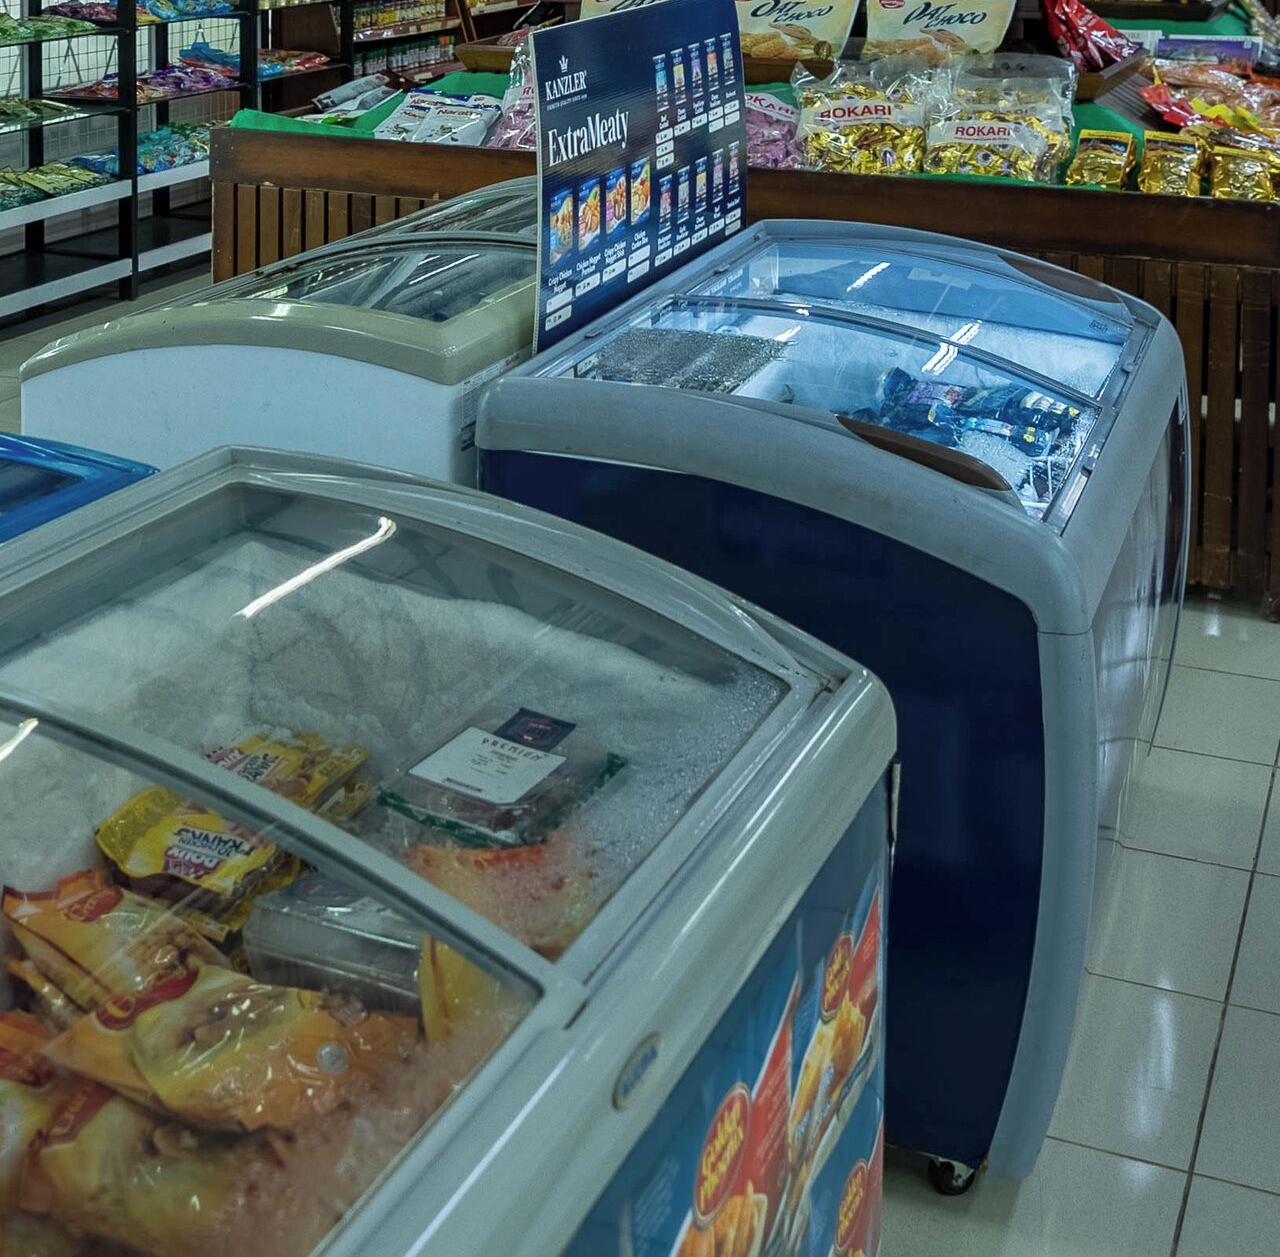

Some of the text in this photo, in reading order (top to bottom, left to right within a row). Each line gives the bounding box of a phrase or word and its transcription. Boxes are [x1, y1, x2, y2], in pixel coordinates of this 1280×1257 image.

[773, 5, 834, 24] CHOCO
[902, 1, 955, 25] OAT
[927, 11, 987, 29] CHOCO
[545, 72, 587, 101] KANZLER
[819, 104, 892, 120] ROKARI
[547, 107, 630, 168] ExtraMeaty
[955, 125, 1012, 137] ROKARI
[482, 737, 543, 762] PREMIUM
[173, 827, 256, 856] FRANKS
[167, 846, 217, 869] DOUX
